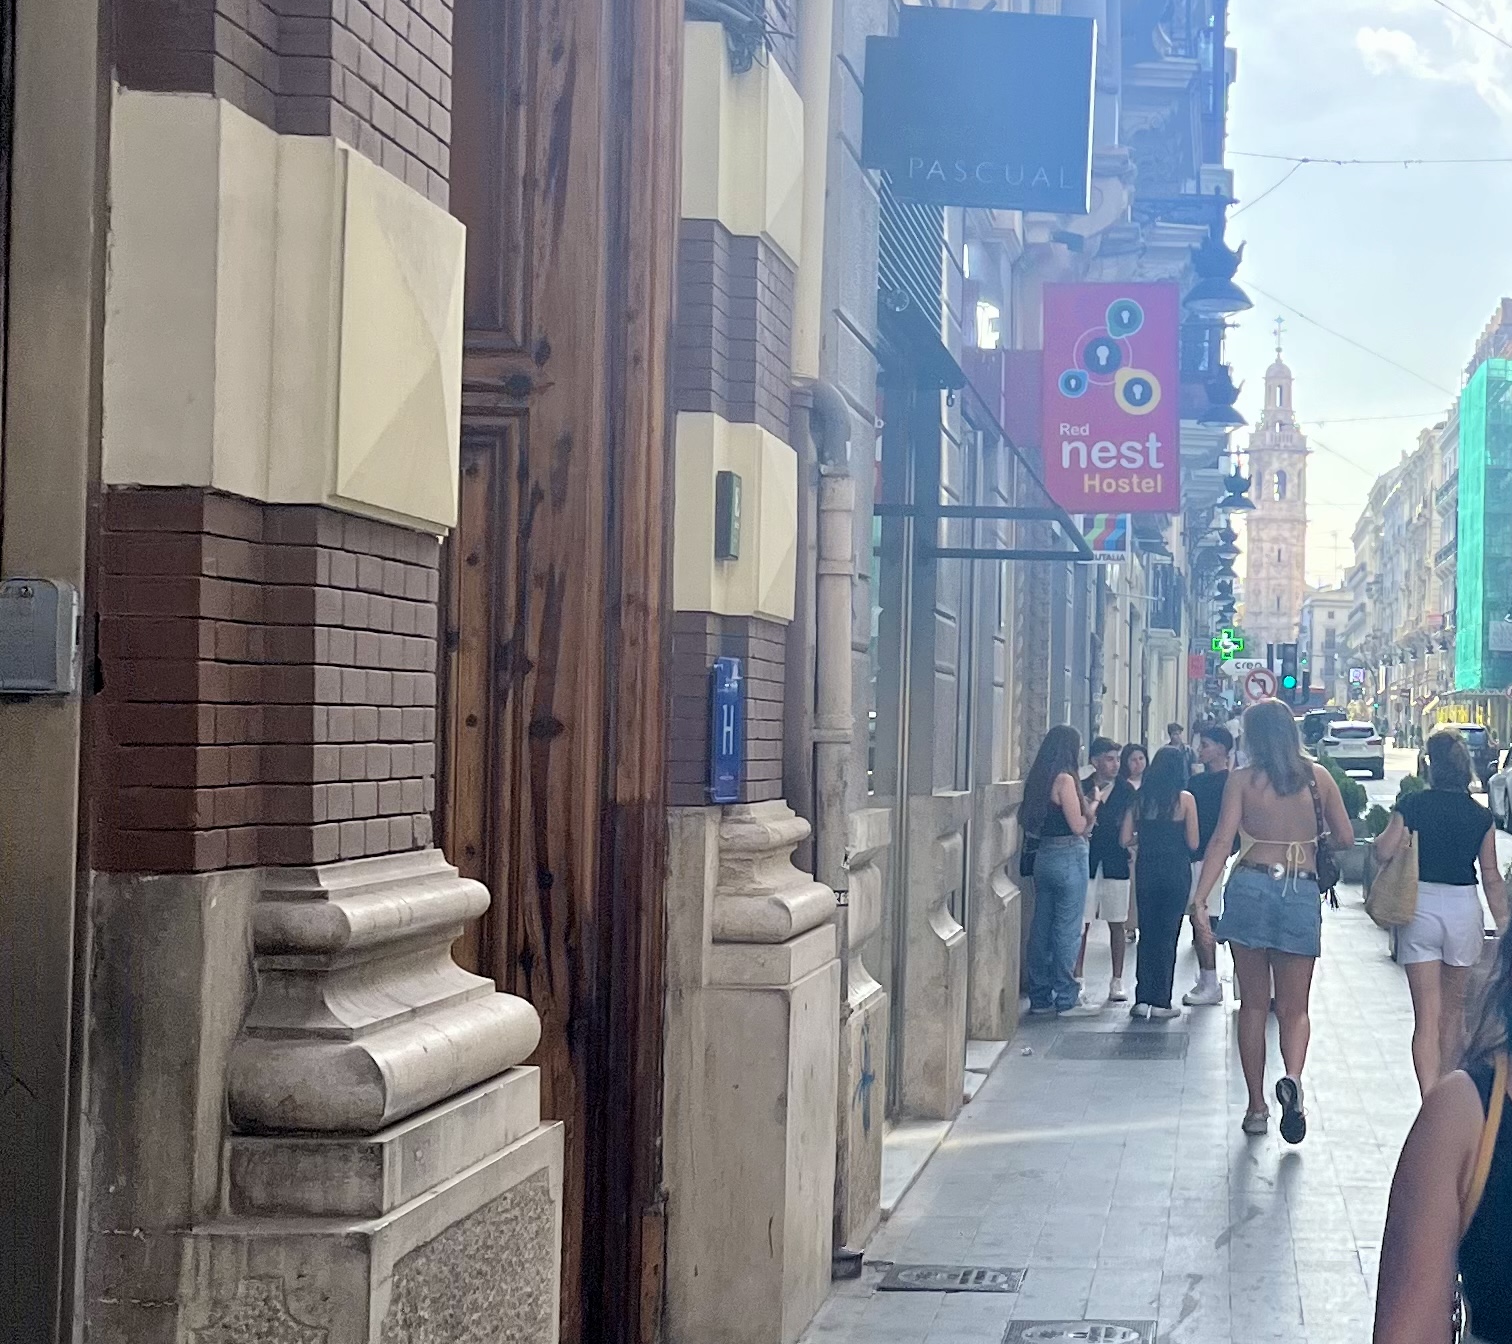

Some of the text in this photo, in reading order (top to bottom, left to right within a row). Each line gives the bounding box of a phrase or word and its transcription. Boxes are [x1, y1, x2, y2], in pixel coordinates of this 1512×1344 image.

[908, 156, 1074, 190] PASCUAL
[1059, 422, 1090, 436] Red
[1061, 431, 1165, 470] nest
[1083, 472, 1162, 494] Hostel
[1093, 552, 1127, 562] UTALIA
